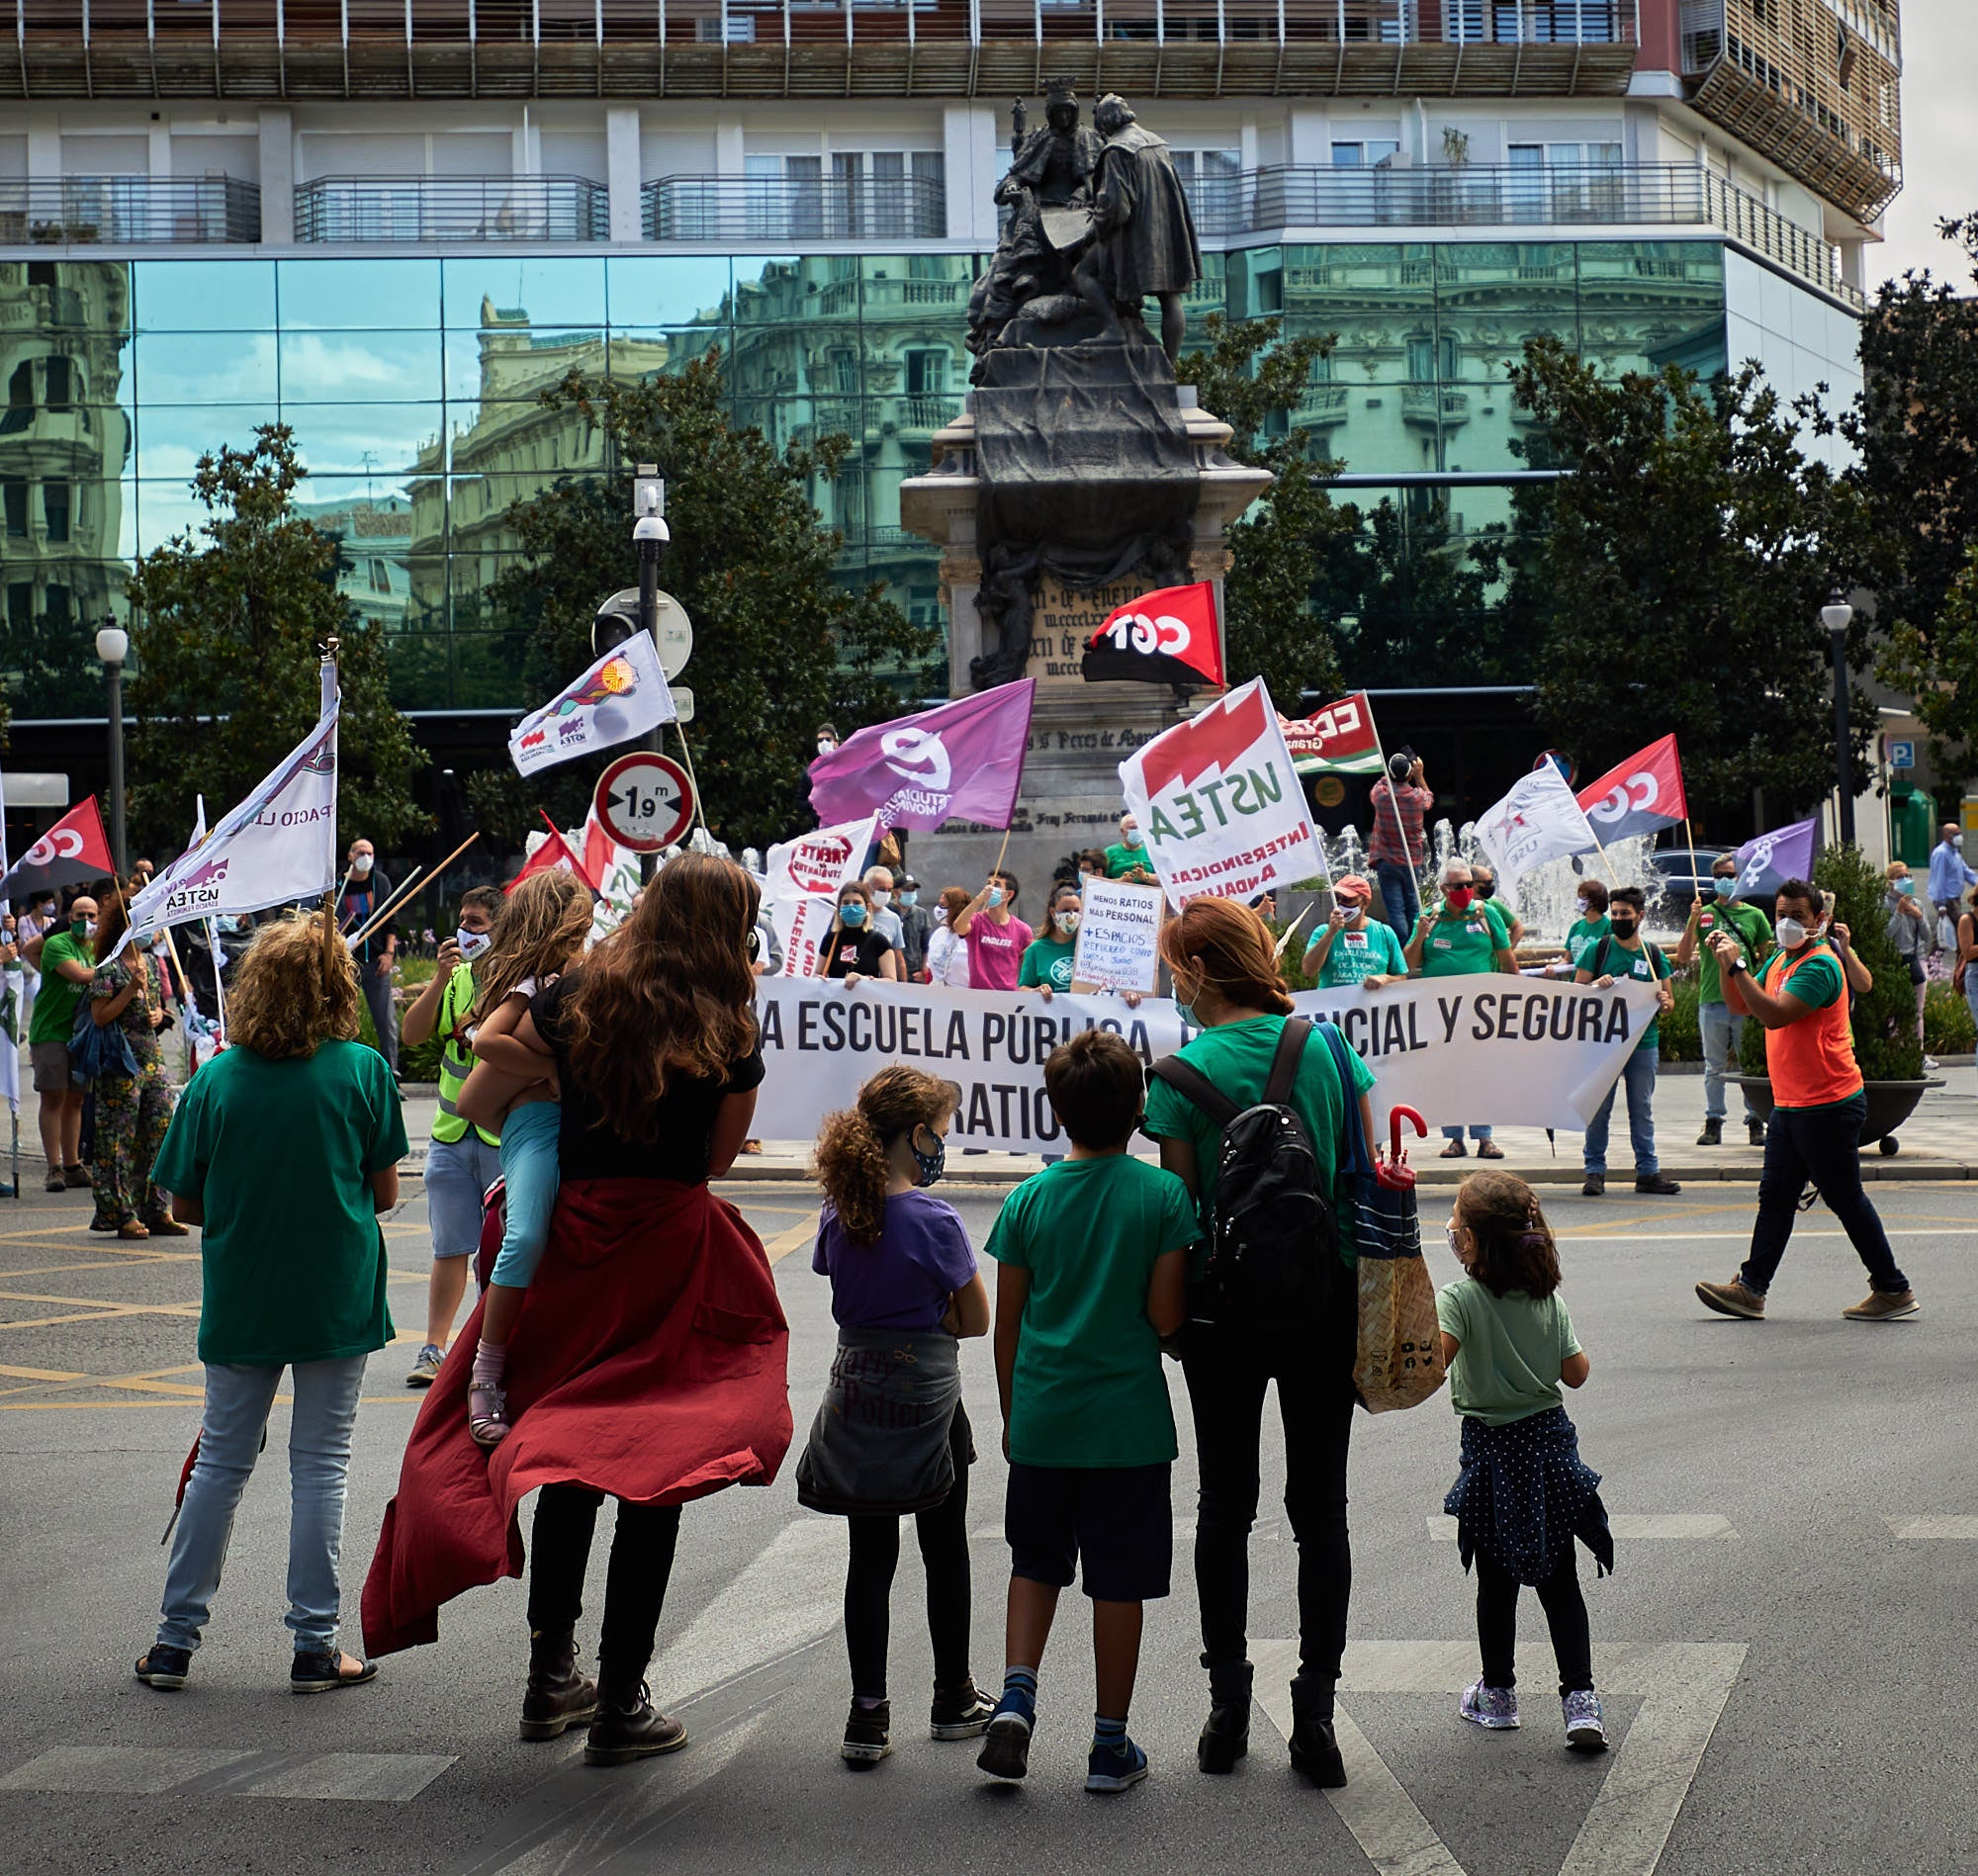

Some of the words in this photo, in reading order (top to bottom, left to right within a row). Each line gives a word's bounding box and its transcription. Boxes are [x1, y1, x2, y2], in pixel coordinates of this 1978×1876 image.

[1893, 745, 1908, 764] P
[655, 786, 669, 797] m
[1093, 894, 1118, 905] MENOS
[1120, 897, 1153, 910] RATIOS
[1106, 909, 1154, 925] PERSONAL
[980, 936, 1014, 947] ENDLESS
[1095, 928, 1146, 946] ESPACIOS
[798, 1000, 970, 1060] ESCUELA
[1437, 994, 1464, 1043] Y
[1472, 993, 1630, 1044] SEGURA
